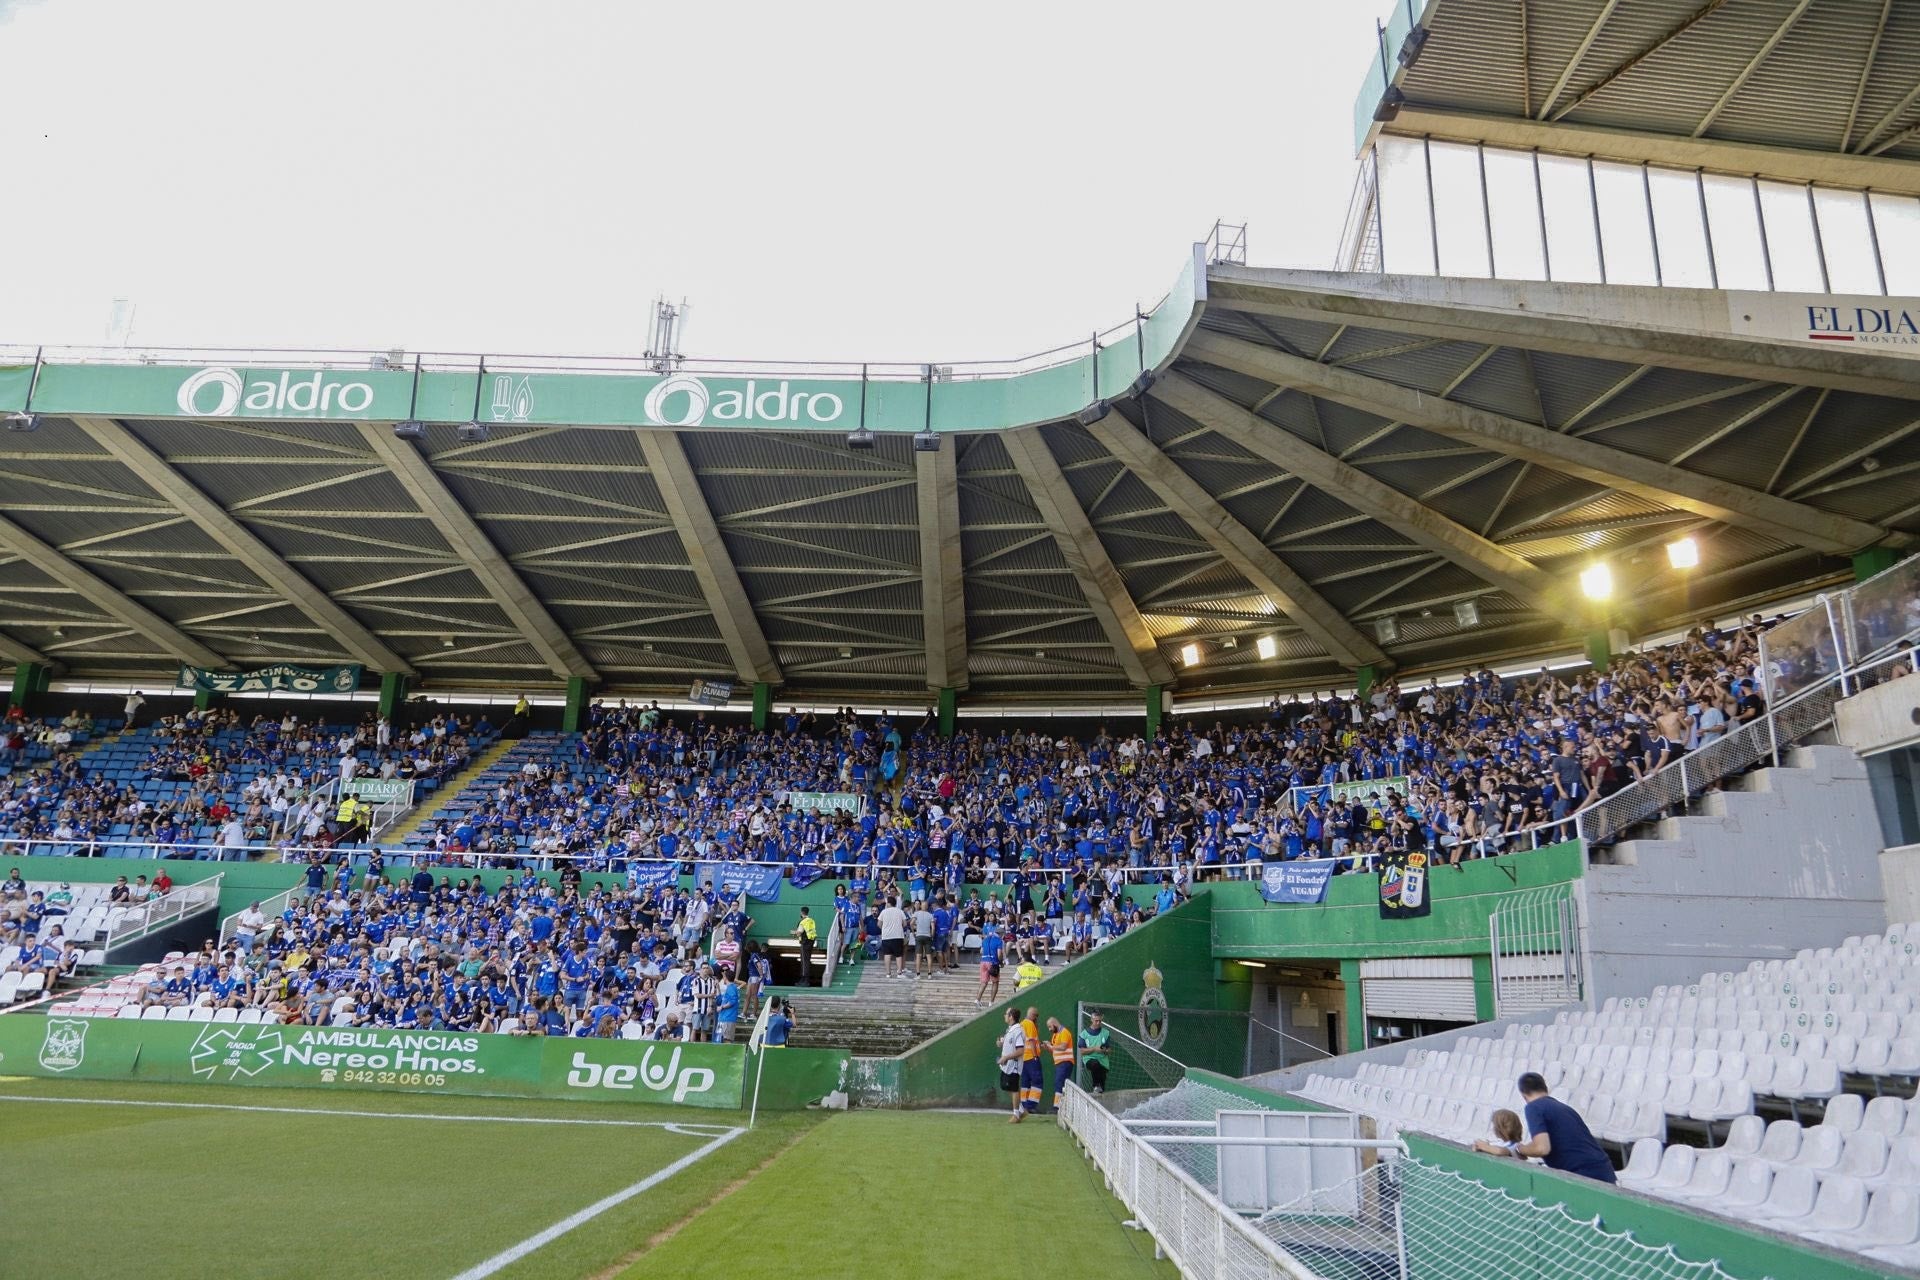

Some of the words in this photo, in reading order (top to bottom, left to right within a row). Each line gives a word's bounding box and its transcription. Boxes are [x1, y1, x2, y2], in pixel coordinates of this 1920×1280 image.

[1805, 306, 1853, 332] EL
[1853, 307, 1920, 335] DIA
[244, 370, 374, 412] aldro
[711, 379, 843, 422] aldro
[211, 676, 318, 691] ZALO
[344, 783, 360, 794] EL
[361, 783, 405, 794] DIARIO
[811, 797, 855, 808] DIARIO
[720, 871, 765, 880] MINUTO
[1286, 875, 1295, 884] El
[297, 1030, 479, 1052] AMBULANCIAS
[283, 1044, 389, 1068] Nereo
[395, 1050, 485, 1074] Hnos.
[343, 1070, 374, 1082] 942
[377, 1072, 396, 1084] 32
[399, 1073, 421, 1085] 06
[424, 1074, 446, 1086] 05
